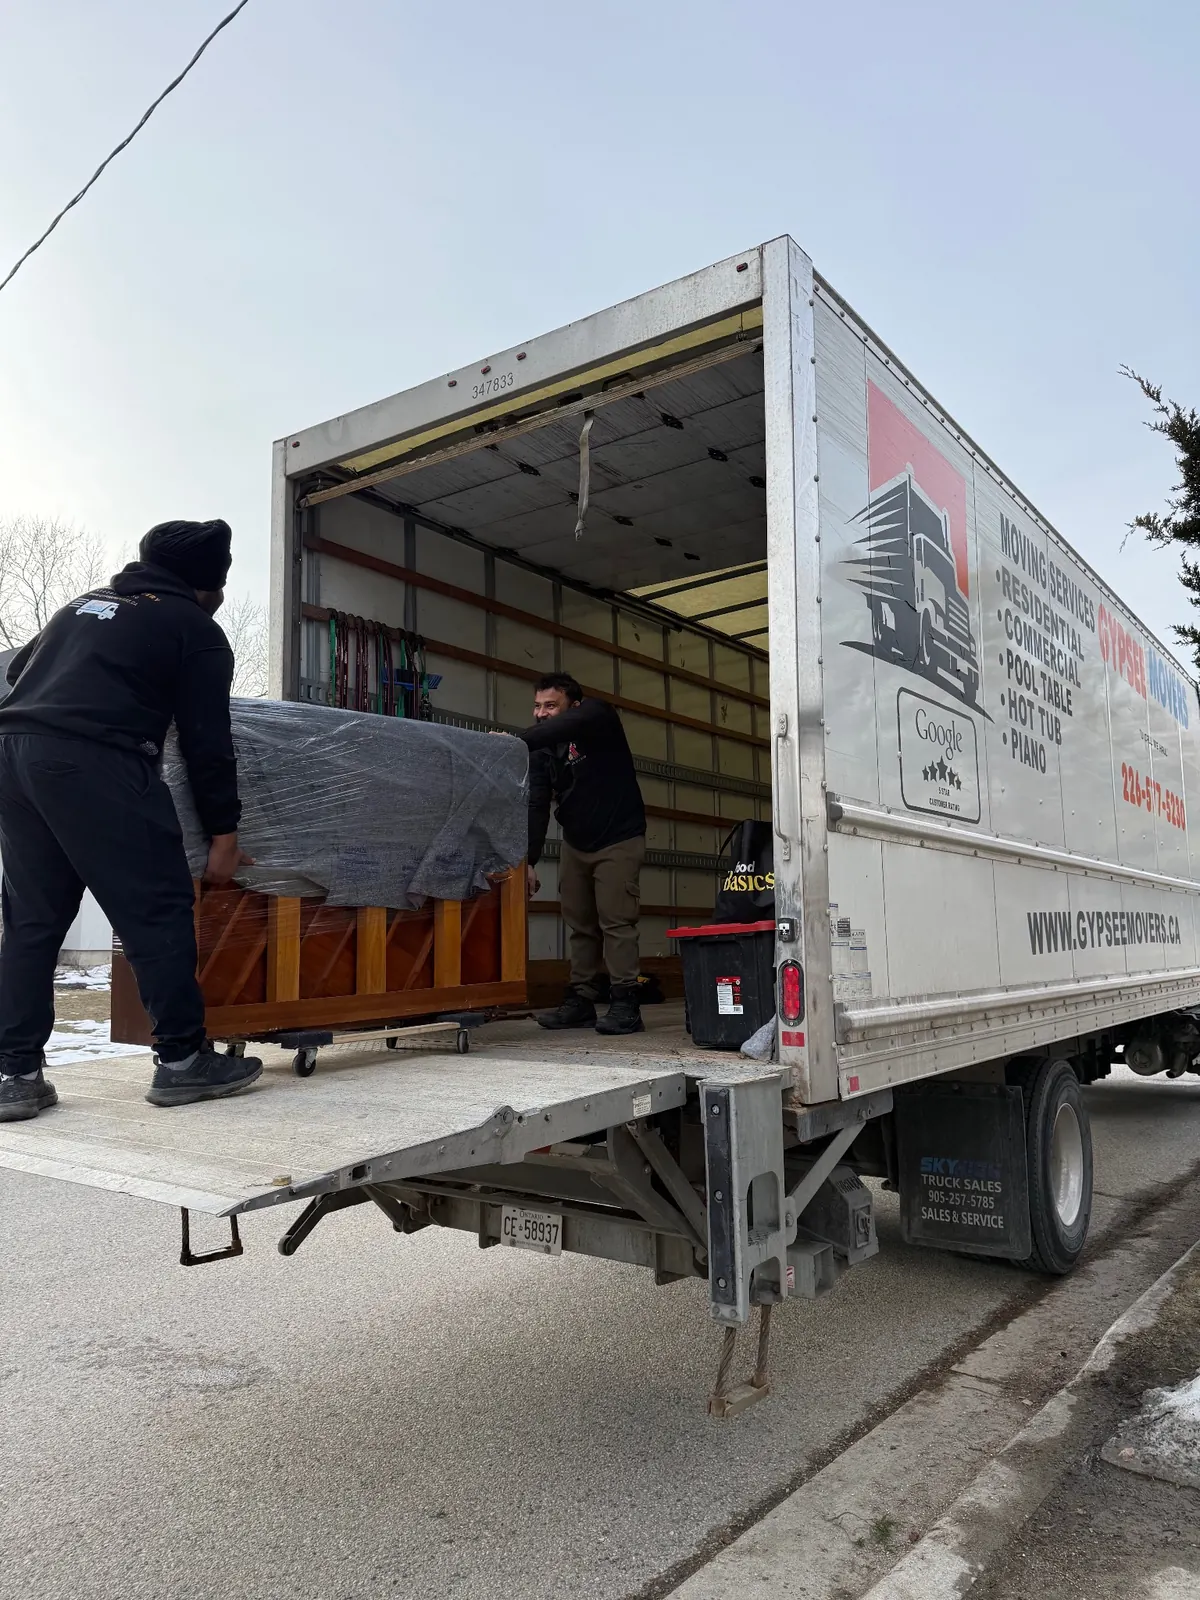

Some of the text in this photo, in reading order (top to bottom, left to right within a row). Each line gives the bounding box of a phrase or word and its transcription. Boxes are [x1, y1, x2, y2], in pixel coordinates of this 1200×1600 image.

[472, 372, 514, 400] 347833
[1000, 511, 1096, 633] MOVING SERVICES
[1001, 565, 1085, 662] RESIDENTIAL
[1004, 608, 1082, 689] COMMERCIAL
[1098, 603, 1189, 730] GYPSEE MOVERS
[1006, 647, 1073, 717] POOL TABLE
[915, 708, 963, 761] Google
[1007, 687, 1063, 746] HOT TUB
[1011, 727, 1047, 774] PIANO
[1027, 910, 1182, 956] WWW.GYPSEEMOVERS.CA
[920, 1173, 1002, 1194] TRUCK SALES
[928, 1189, 995, 1210] 905-257-5785
[921, 1206, 1004, 1229] SALES & SERVICE
